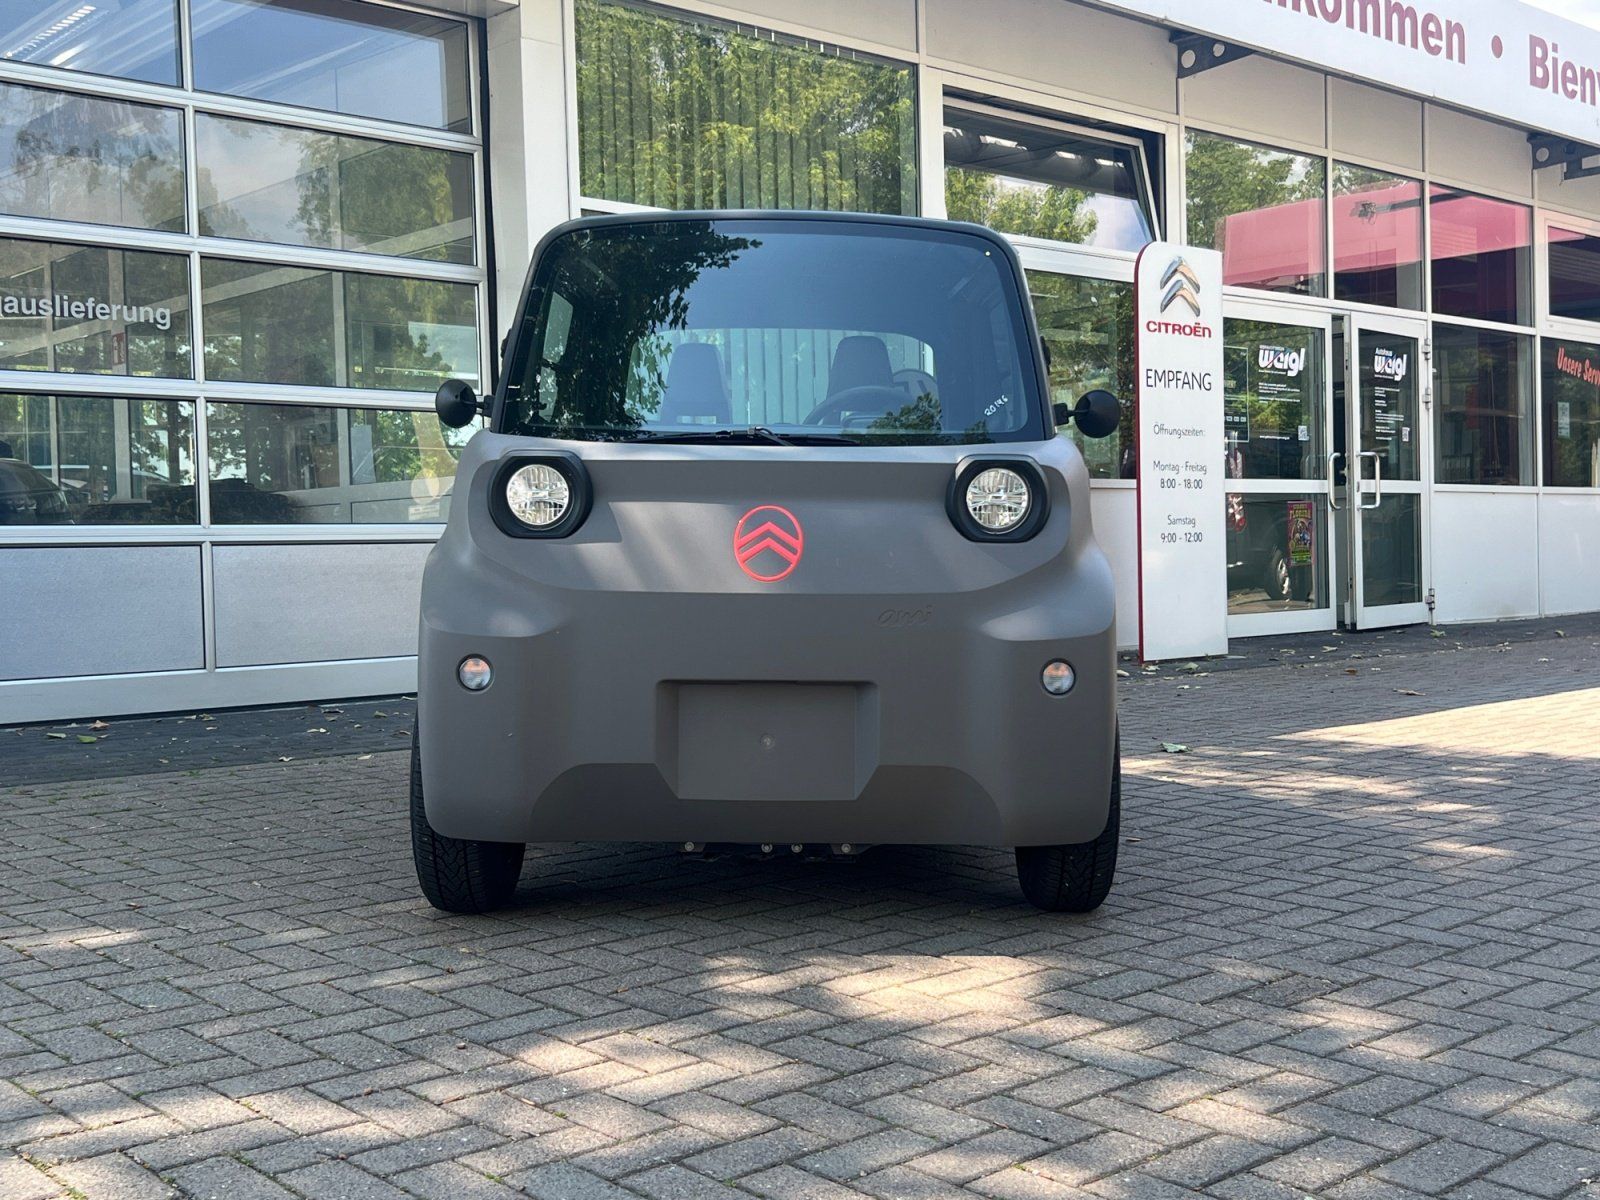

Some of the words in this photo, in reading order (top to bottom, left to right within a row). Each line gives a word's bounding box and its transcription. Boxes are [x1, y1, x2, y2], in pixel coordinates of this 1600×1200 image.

[1529, 33, 1600, 107] Bien
[0, 294, 171, 330] auslieferung
[1557, 346, 1582, 379] Unsere
[1146, 368, 1212, 391] EMPFANG
[1153, 460, 1180, 475] Montag
[1184, 461, 1207, 475] Freitag
[1167, 514, 1196, 528] Samstag
